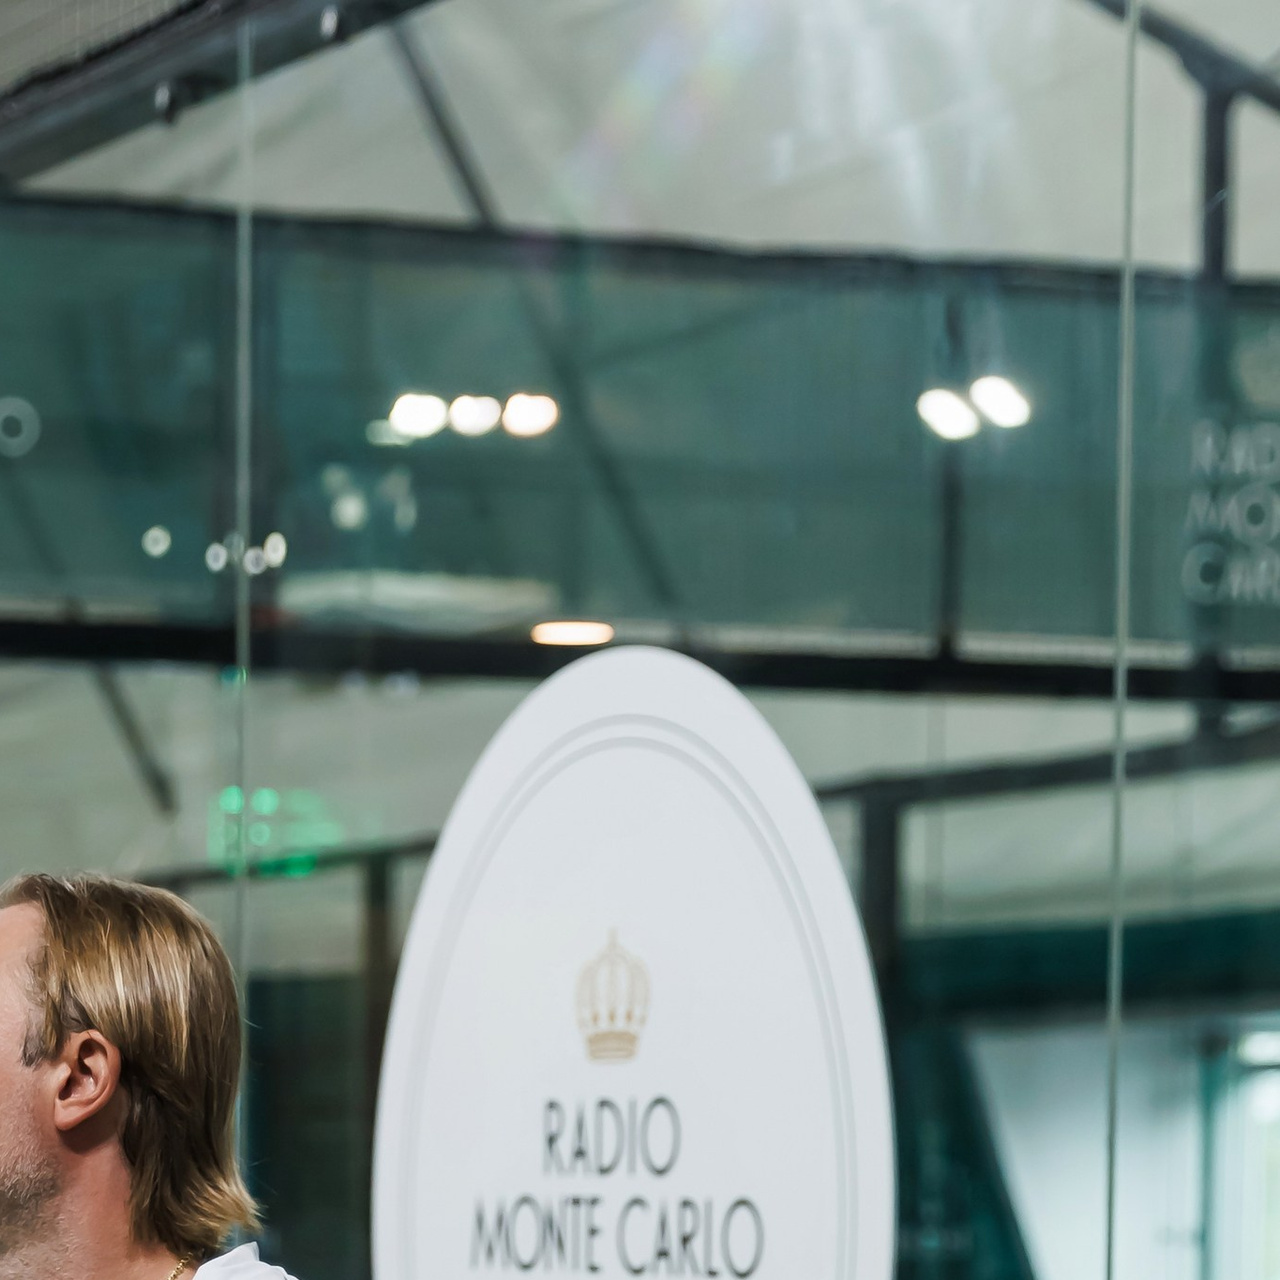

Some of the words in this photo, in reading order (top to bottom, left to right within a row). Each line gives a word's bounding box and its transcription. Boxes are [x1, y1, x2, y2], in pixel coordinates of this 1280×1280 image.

[542, 1096, 682, 1177] RADIO
[470, 1196, 604, 1273] MONTE
[616, 1197, 765, 1279] CARLO
